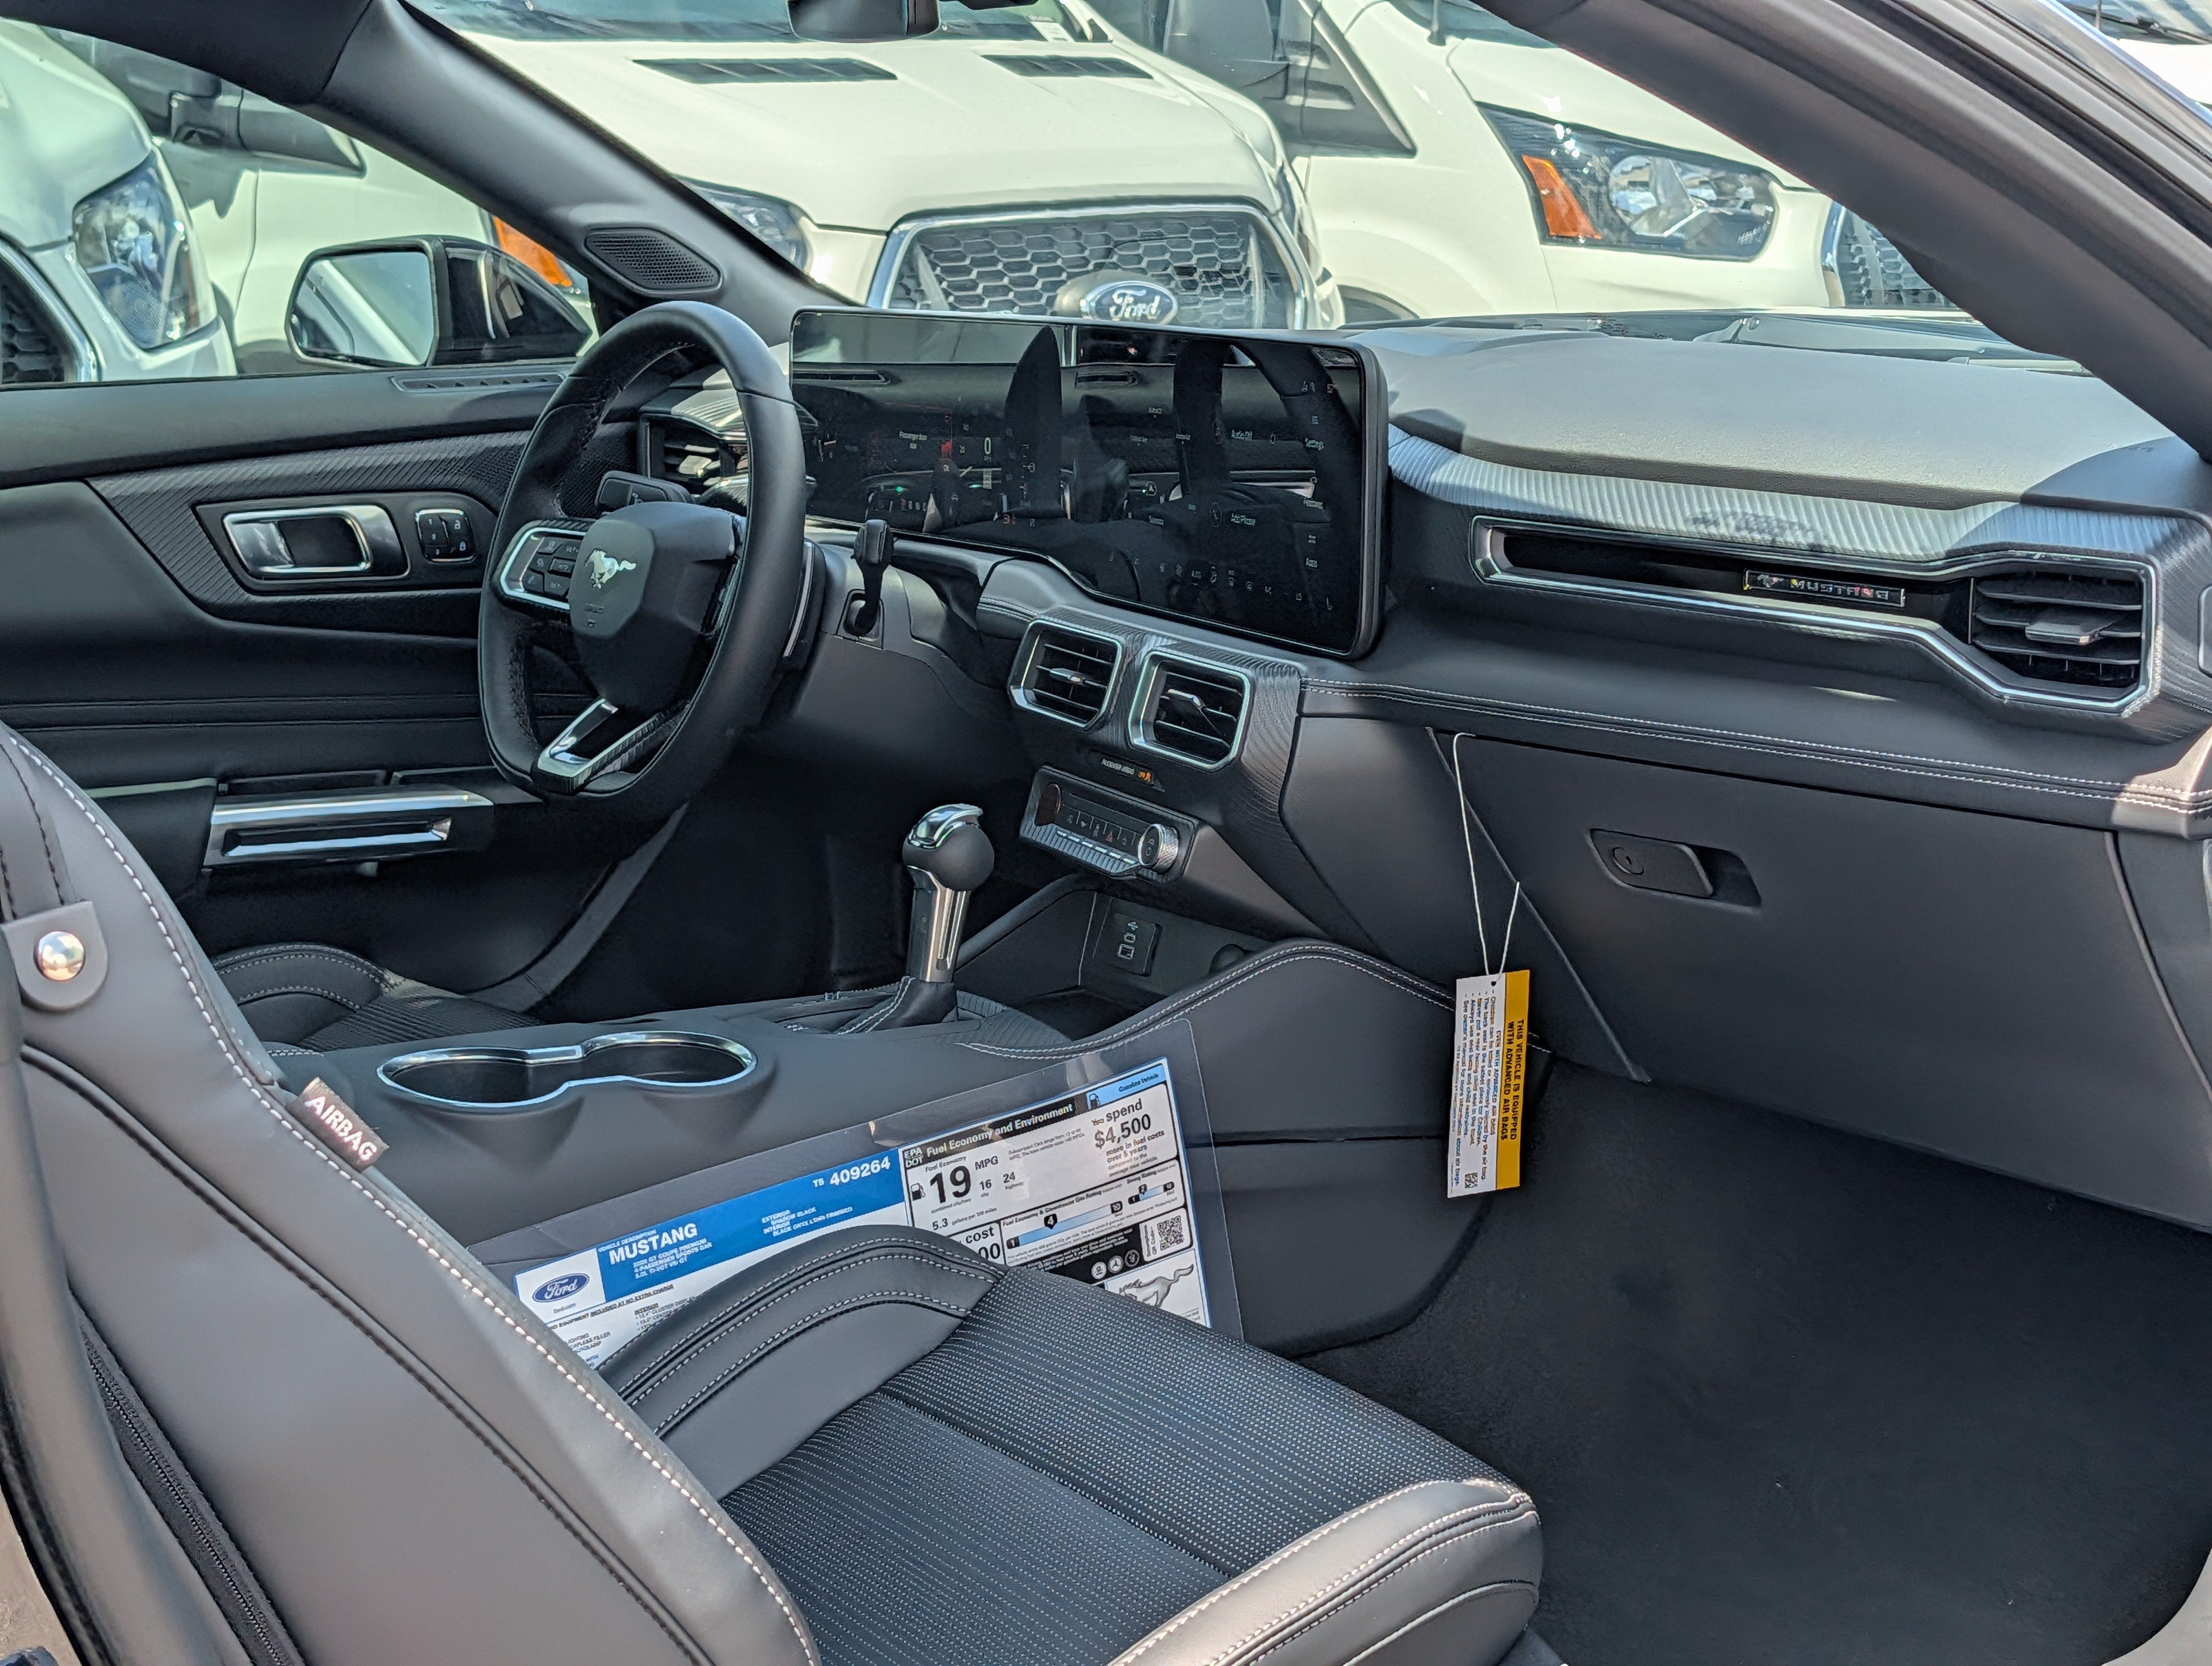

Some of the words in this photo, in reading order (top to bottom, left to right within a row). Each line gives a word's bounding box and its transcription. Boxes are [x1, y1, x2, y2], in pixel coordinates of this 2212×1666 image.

[1109, 289, 1161, 322] Ford
[1790, 579, 1889, 600] MUSTANG
[1506, 1021, 1514, 1045] WITH
[1516, 1018, 1524, 1040] THIS
[1503, 1047, 1513, 1095] ADVANCED
[1513, 1042, 1523, 1081] VEHICLE
[1104, 1097, 1143, 1125] spend
[1502, 1098, 1510, 1114] AIR
[304, 1095, 378, 1161] AIRBAG
[925, 1141, 948, 1158] Fuel
[948, 1125, 994, 1152] Economy
[993, 1120, 1014, 1137] and
[1013, 1101, 1073, 1131] Environment
[1092, 1112, 1153, 1151] $4,500
[1146, 1129, 1165, 1141] costs
[1500, 1116, 1509, 1140] BAGS
[828, 1154, 892, 1188] 409264
[928, 1162, 974, 1207] 19
[974, 1155, 999, 1171] MPG
[978, 1178, 993, 1191] 16
[1002, 1170, 1016, 1184] 24
[931, 1216, 949, 1232] 5.3
[964, 1225, 995, 1245] cost
[608, 1221, 698, 1265] MUSTANG
[544, 1278, 578, 1300] Ford
